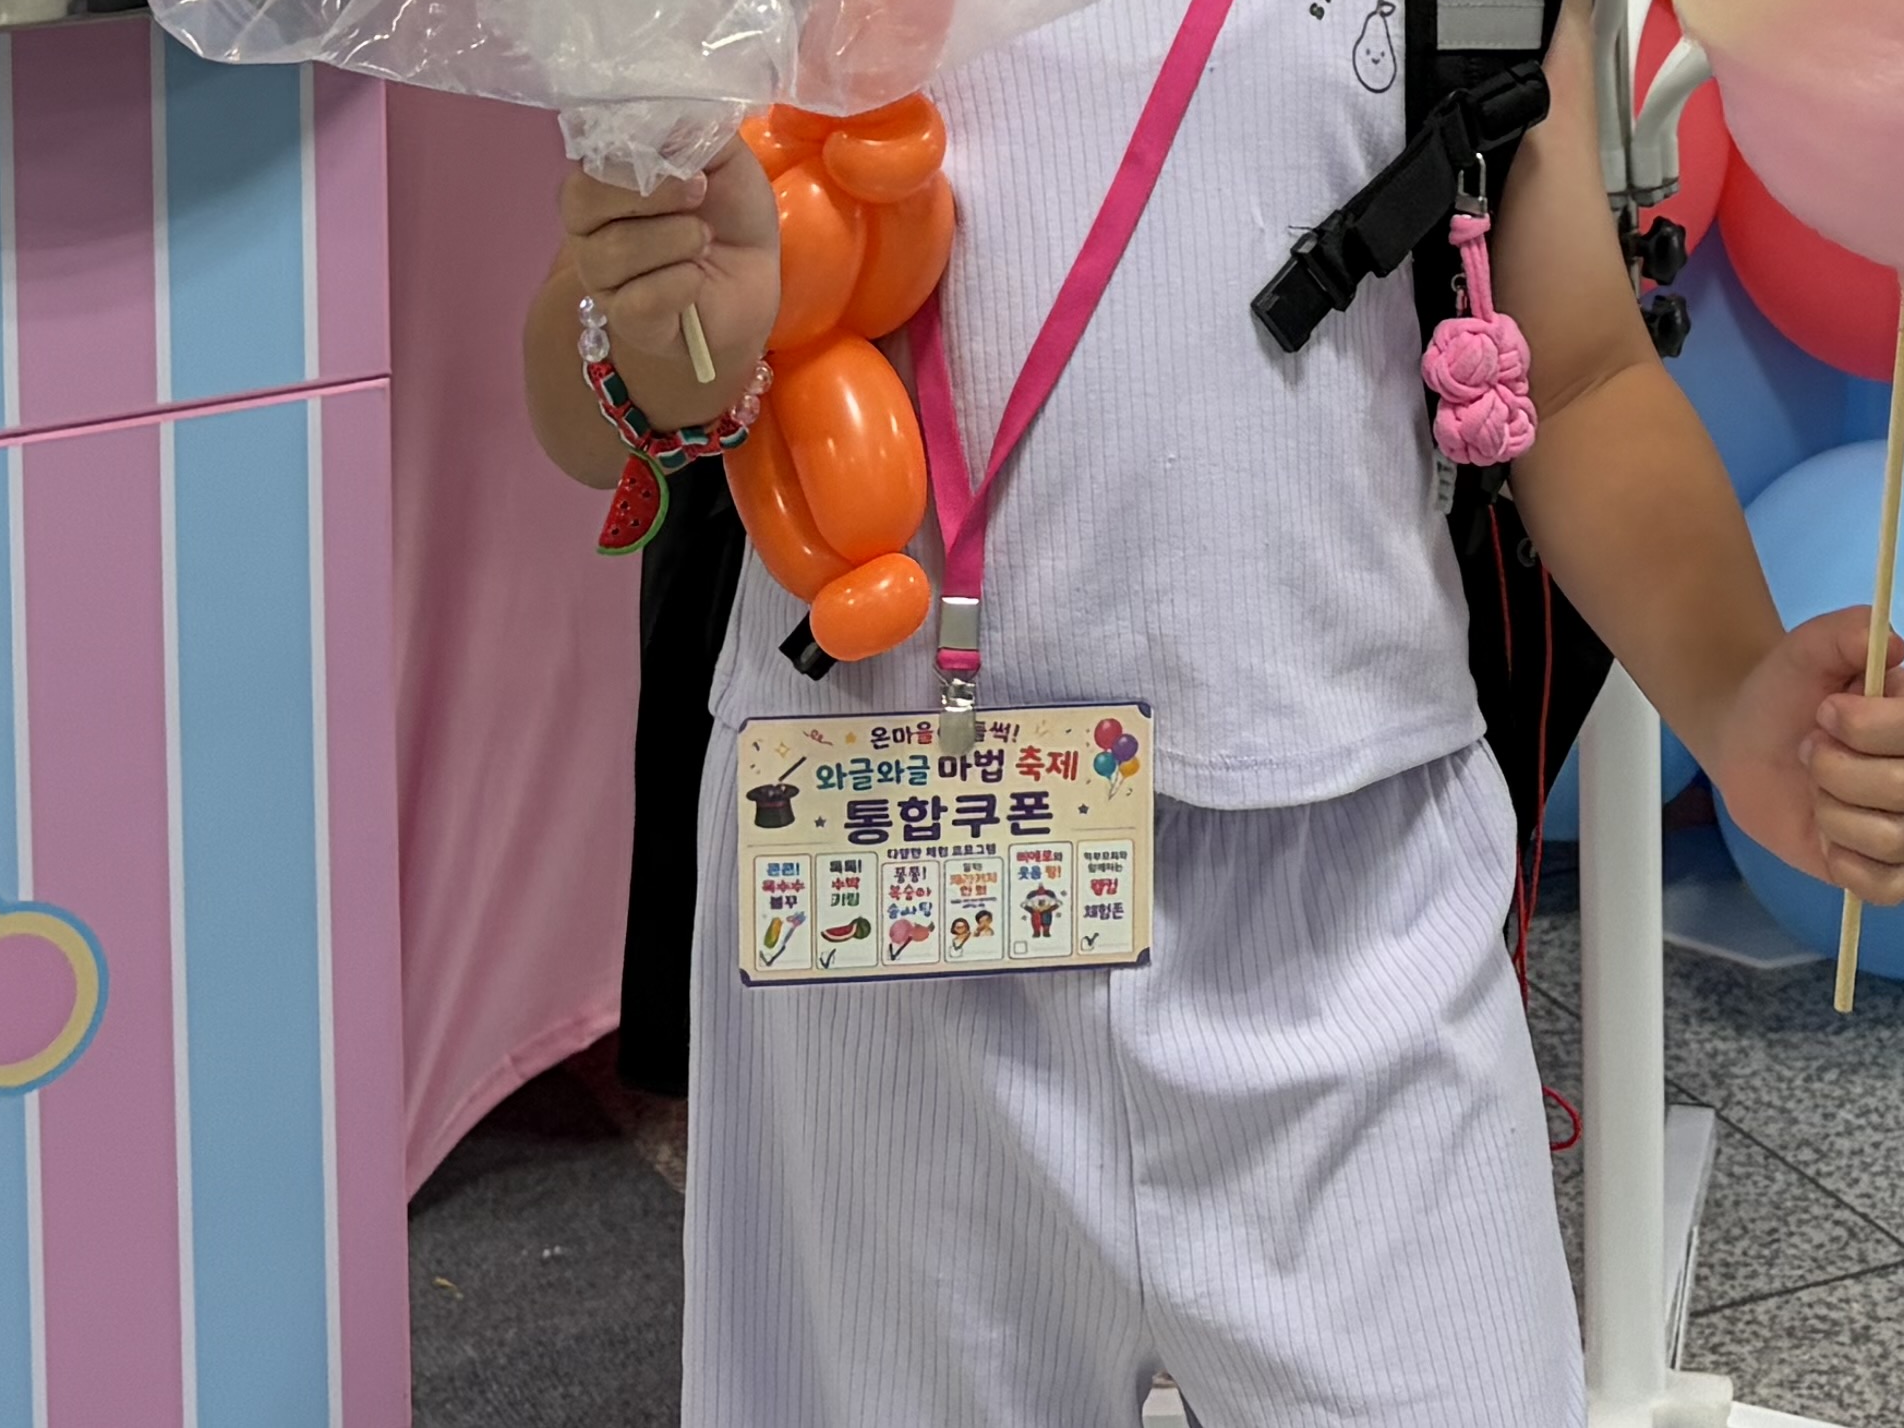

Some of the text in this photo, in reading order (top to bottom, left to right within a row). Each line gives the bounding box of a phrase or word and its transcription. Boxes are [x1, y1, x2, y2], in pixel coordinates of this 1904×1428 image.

[870, 721, 943, 750] 온마을
[816, 745, 1079, 791] 와글와글 마법 축제
[844, 791, 1053, 845] 통합쿠폰
